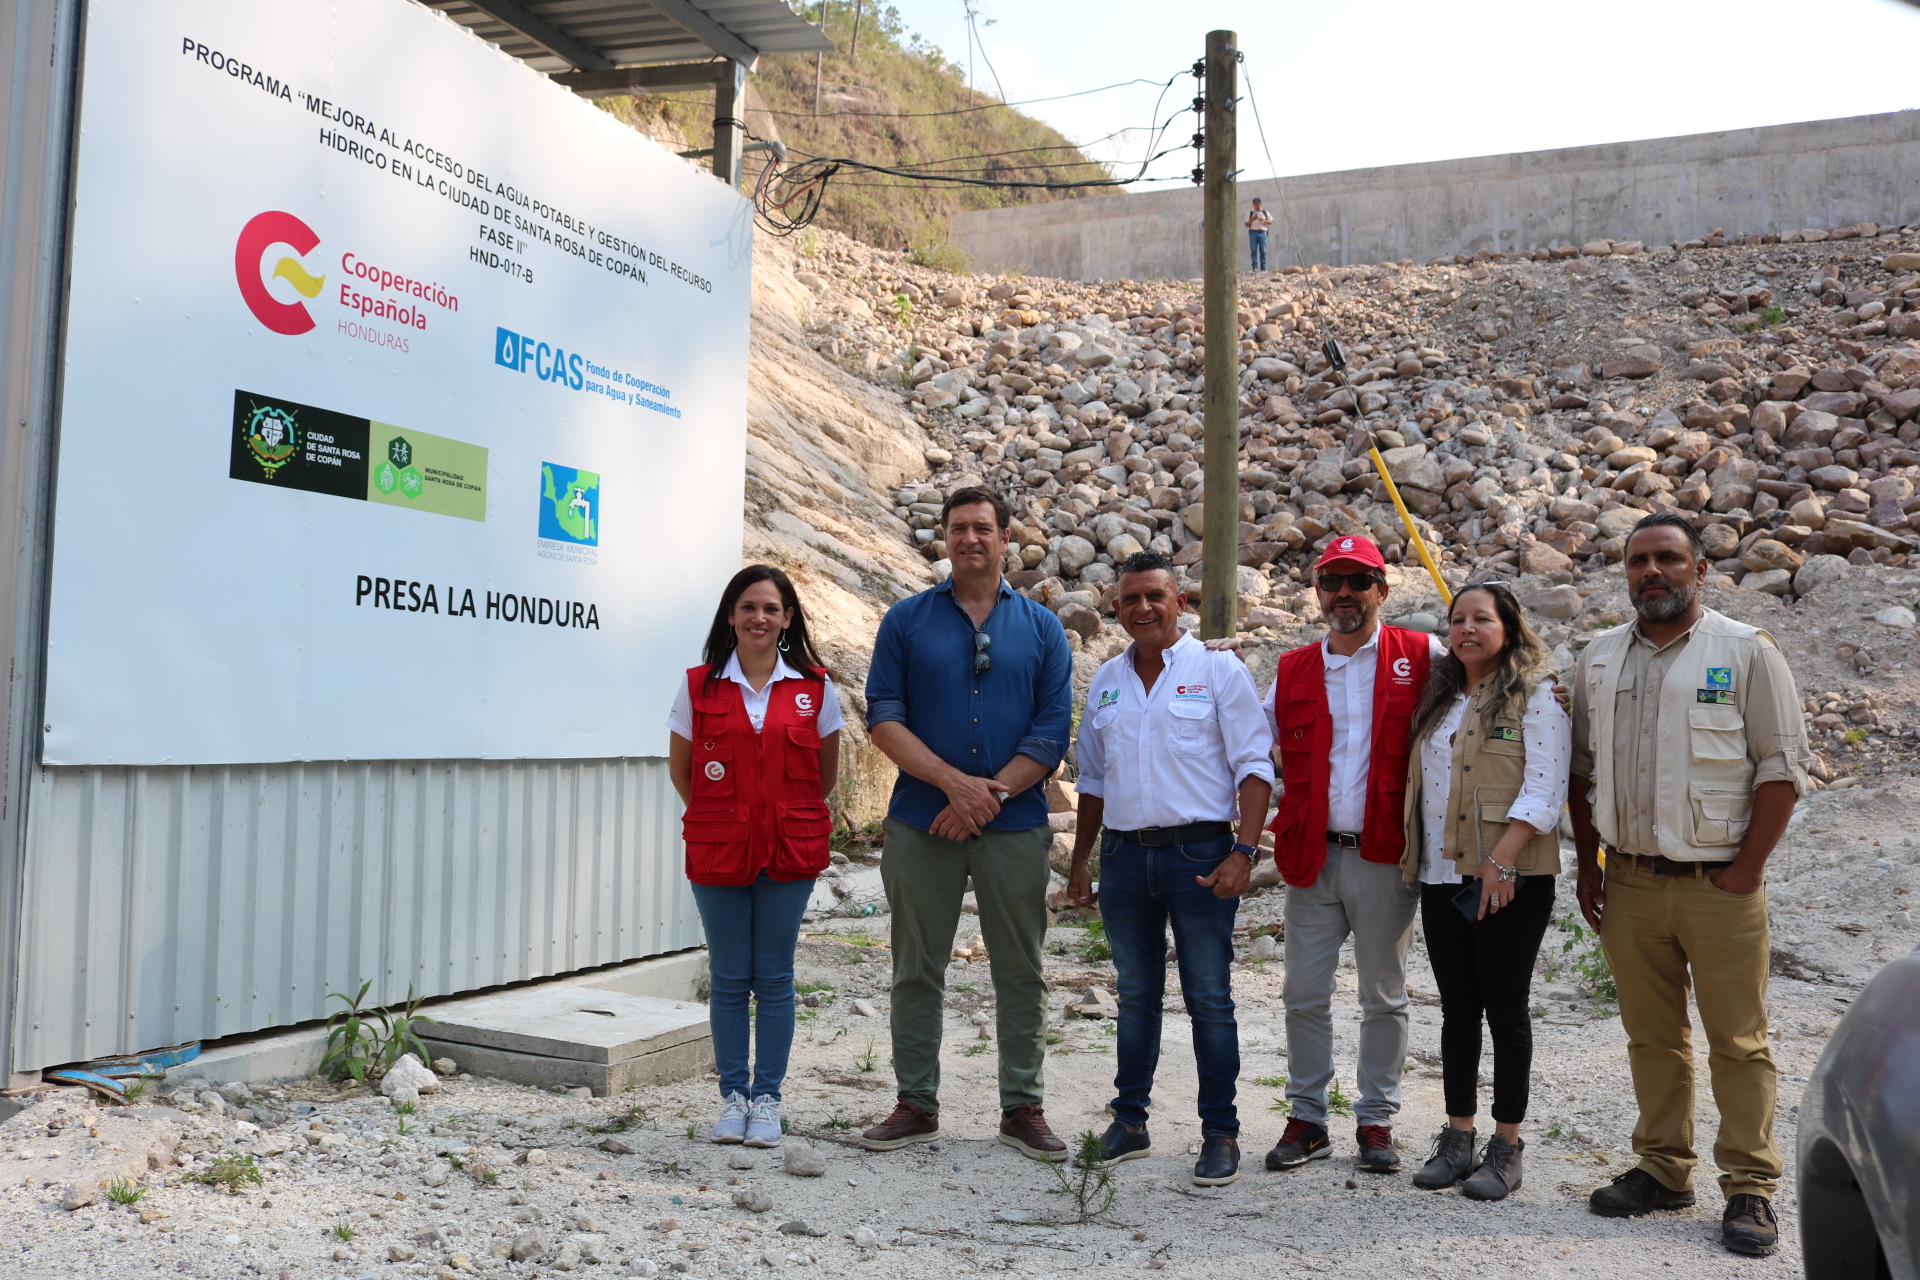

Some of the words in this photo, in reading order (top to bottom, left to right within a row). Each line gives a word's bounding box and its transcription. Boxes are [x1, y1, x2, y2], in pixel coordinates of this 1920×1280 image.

[182, 37, 292, 103] PROGRAMA
[379, 128, 400, 149] AL
[404, 139, 463, 178] ACCESO
[467, 169, 492, 193] DEL
[496, 182, 530, 211] AGUA
[533, 200, 585, 236] POTABLE
[588, 225, 595, 240] Y
[597, 231, 646, 262] GESTIÓN
[649, 252, 668, 272] DEL
[670, 262, 712, 293] RECURSO
[319, 127, 387, 169] HÍDRICO
[392, 159, 412, 181] EN
[417, 170, 435, 191] LA
[439, 180, 489, 215] CIUDAD
[494, 205, 511, 225] DE
[514, 215, 551, 244] SANTA
[554, 233, 586, 260] ROSA
[588, 249, 603, 267] DE
[606, 257, 648, 286] COPÁN,
[479, 224, 514, 250] FASE
[341, 252, 459, 312] Cooperación
[470, 245, 533, 284] HND-017-B
[340, 283, 426, 330] Española
[338, 318, 410, 353] HONDURAS
[520, 335, 583, 391] FCAS
[586, 360, 610, 379] Fondo
[612, 370, 623, 383] de
[625, 373, 670, 399] Cooperación
[586, 380, 604, 394] para
[606, 384, 626, 401] Agua
[628, 393, 634, 405] y
[635, 393, 681, 419] Saneamiento
[306, 431, 334, 444] CIUDAD
[306, 442, 317, 451] DE
[317, 444, 341, 456] SANTA
[341, 448, 361, 460] ROSA
[305, 452, 316, 462] DE
[317, 454, 342, 467] COPÁN
[424, 467, 464, 481] MUNICIPALIDAD
[424, 475, 441, 483] SANTA
[441, 478, 455, 486] ROSA
[537, 540, 564, 551] EMPRESA
[566, 544, 598, 557] MUNICIPAL
[537, 550, 556, 560] AGUAS
[557, 553, 565, 561] DE
[565, 554, 582, 564] SANTA
[582, 556, 598, 566] ROSA
[356, 575, 439, 614] PRESA
[447, 586, 476, 618] LA
[486, 590, 600, 631] HONDURA
